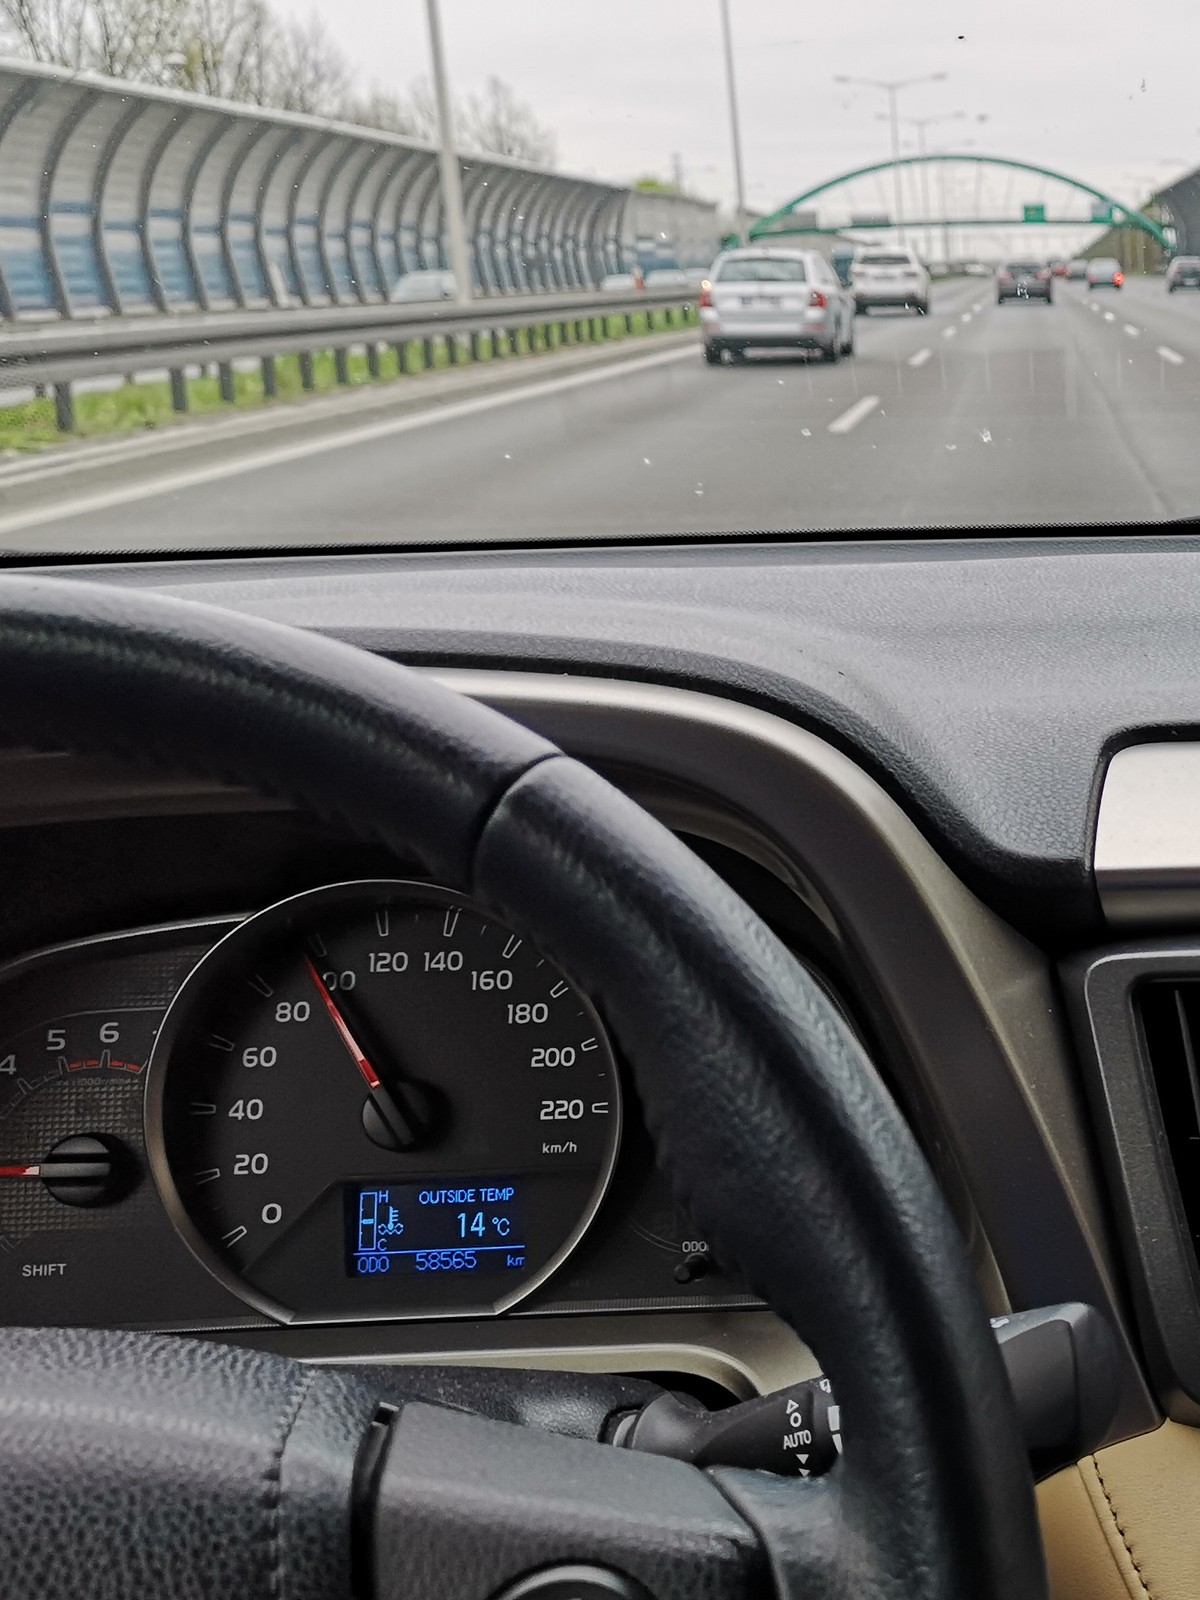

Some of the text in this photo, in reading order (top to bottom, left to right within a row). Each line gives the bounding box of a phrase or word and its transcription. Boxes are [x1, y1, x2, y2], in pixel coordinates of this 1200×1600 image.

[368, 951, 409, 973] 120
[423, 950, 464, 972] 140
[322, 970, 356, 991] 00
[471, 969, 513, 991] 160
[275, 1001, 311, 1023] 80
[507, 1002, 549, 1024] 180
[46, 1029, 66, 1051] 5
[100, 1022, 120, 1043] 6
[0, 1054, 17, 1075] 4
[242, 1046, 277, 1068] 60
[530, 1046, 576, 1068] 200
[228, 1098, 264, 1121] 40
[540, 1099, 584, 1120] 220
[542, 1141, 578, 1154] km/h
[233, 1153, 269, 1175] 20
[378, 1190, 389, 1204] H
[419, 1187, 515, 1205] OUTSIDE TEMP
[261, 1203, 283, 1224] 0
[457, 1212, 486, 1238] 14
[377, 1238, 388, 1251] C
[22, 1263, 67, 1277] SHIFT
[357, 1256, 390, 1274] ODO
[415, 1251, 477, 1271] 58565
[783, 1430, 811, 1450] AUTO
